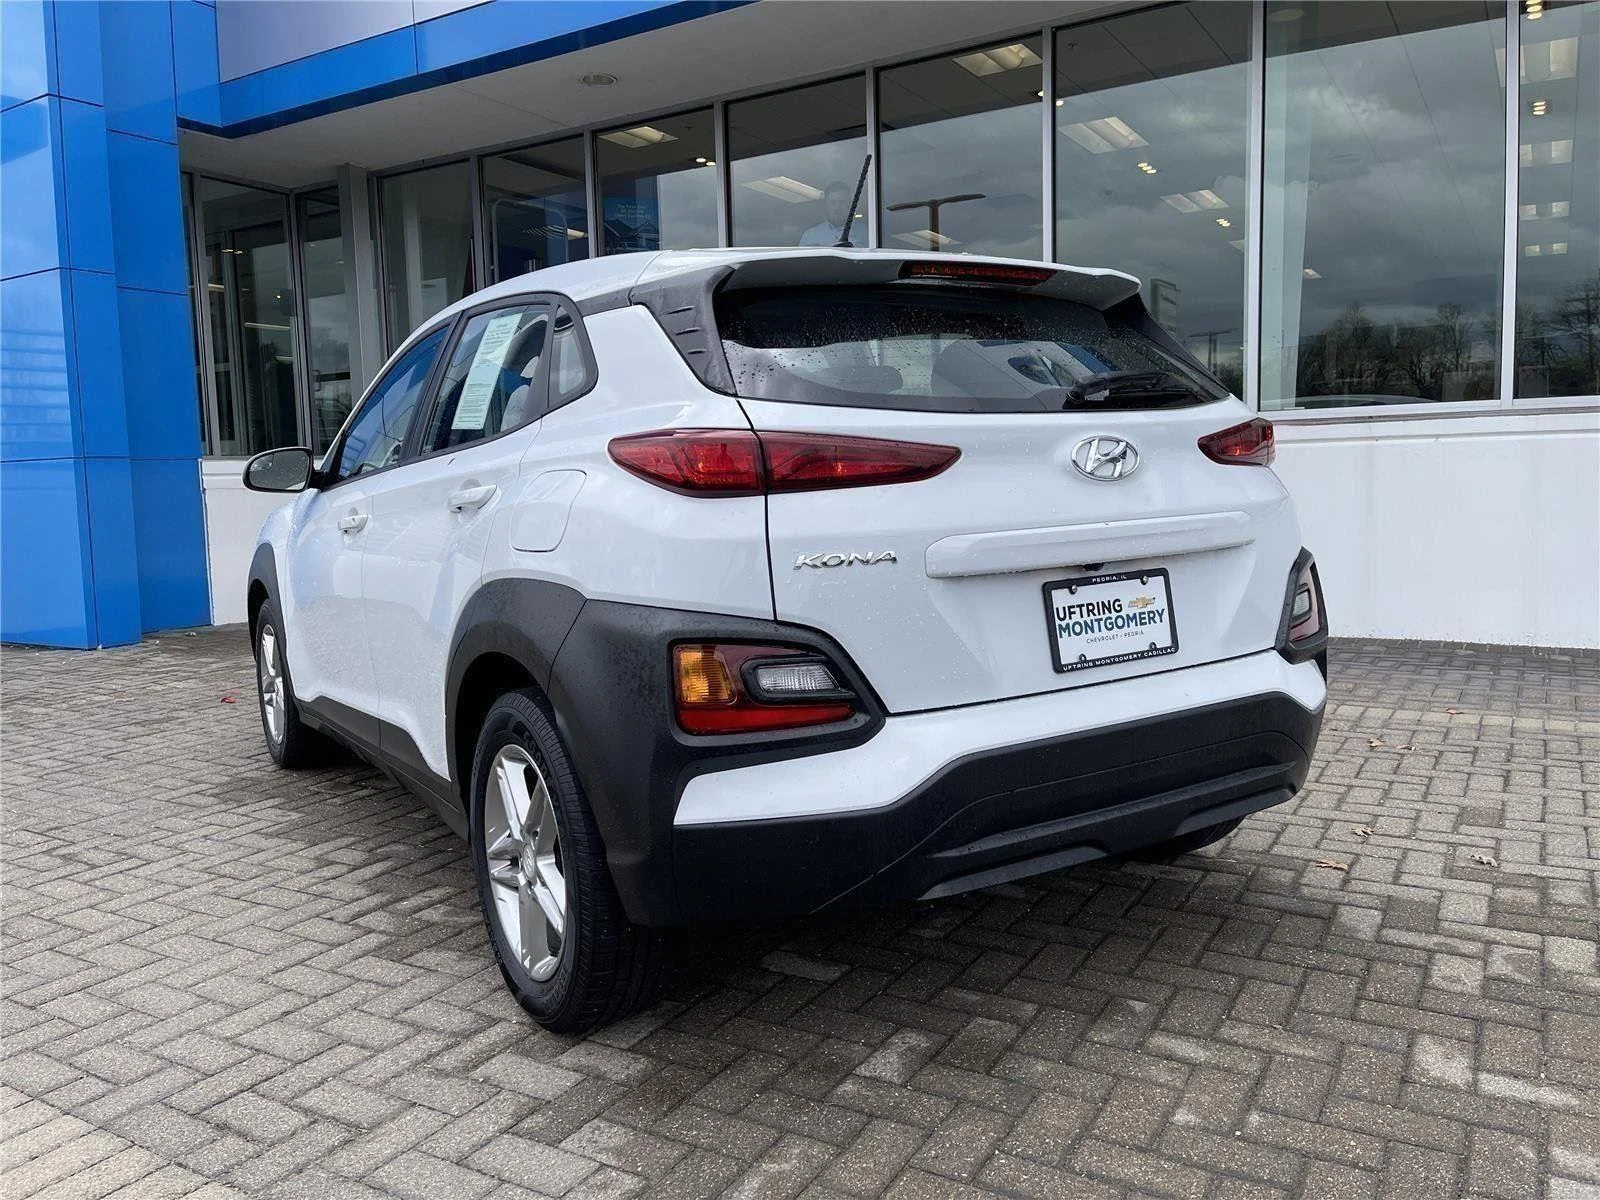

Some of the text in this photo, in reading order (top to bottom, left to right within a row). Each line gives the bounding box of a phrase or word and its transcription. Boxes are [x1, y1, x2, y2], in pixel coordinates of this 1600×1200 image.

[793, 550, 898, 570] KONA
[1056, 599, 1122, 621] UFTRING
[1058, 608, 1165, 639] MONTGOMERY
[1086, 630, 1145, 644] CHEVROLET PEORIA
[1063, 647, 1176, 671] UFTRING MONTGOMERY CADILLAC
